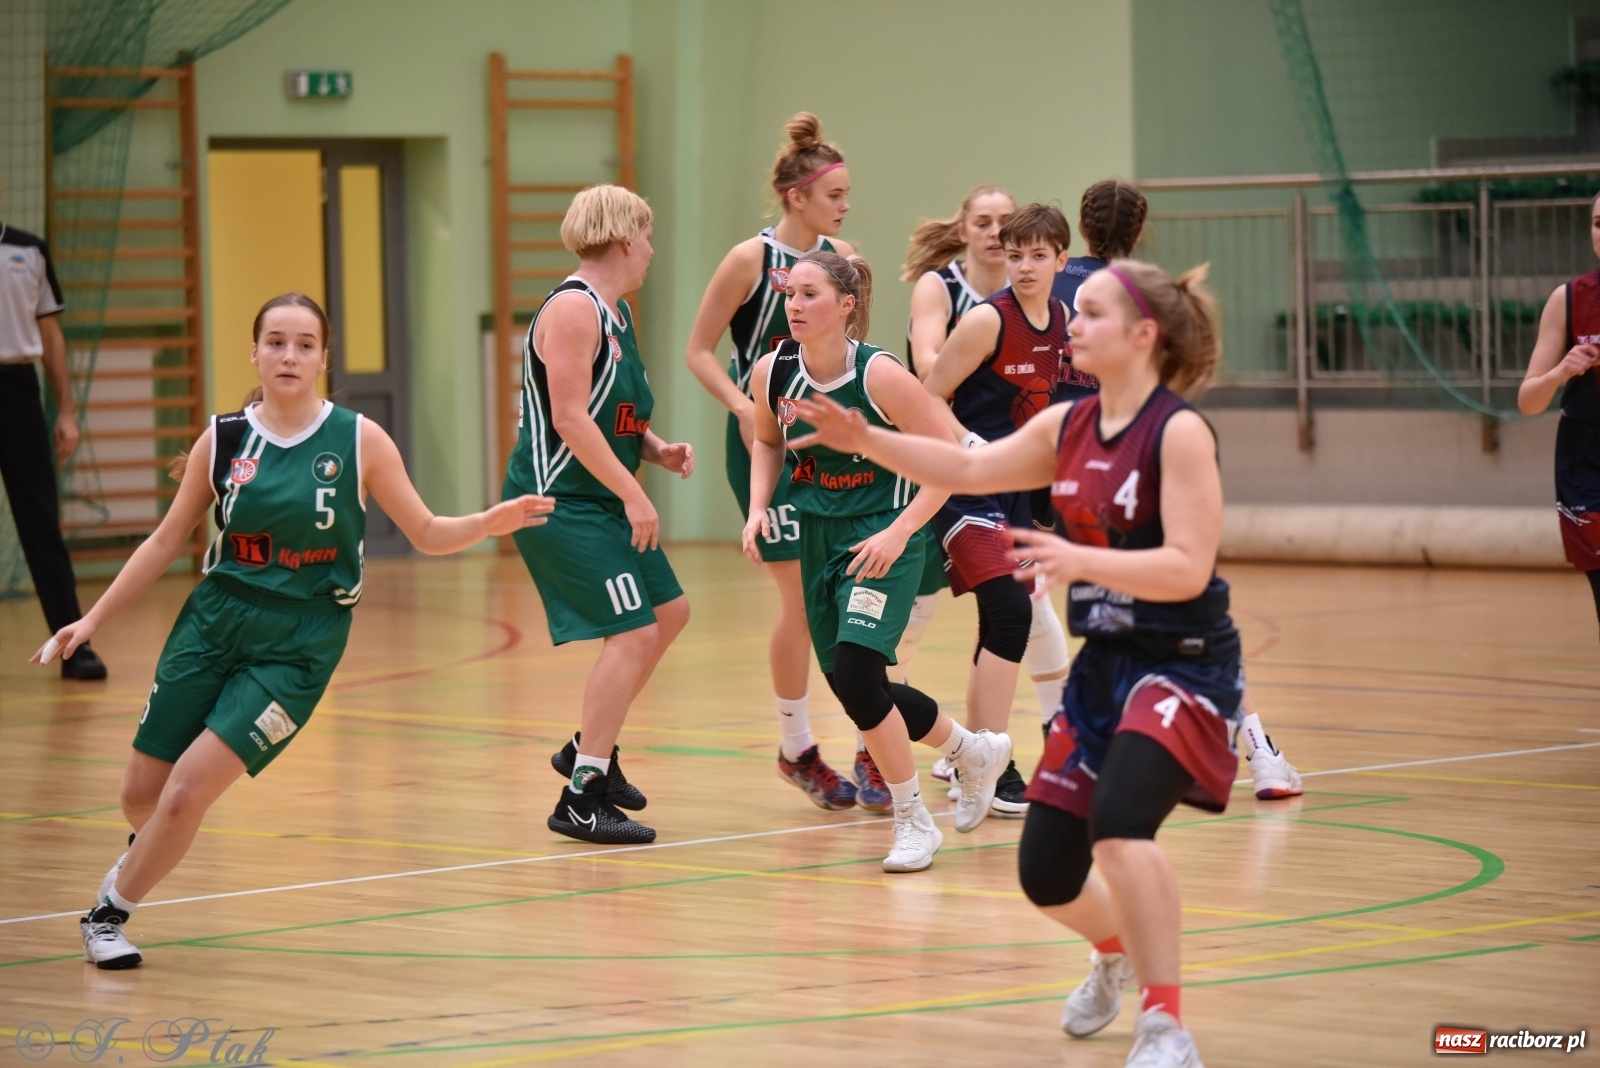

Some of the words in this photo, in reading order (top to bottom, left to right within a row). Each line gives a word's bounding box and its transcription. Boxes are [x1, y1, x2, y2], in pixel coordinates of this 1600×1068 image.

[1057, 361, 1099, 389] OLSKA
[820, 469, 874, 490] KAMAN
[1112, 469, 1140, 521] 4
[315, 487, 336, 530] 5
[605, 572, 642, 615] 10
[847, 617, 877, 629] COLO
[1153, 694, 1181, 729] 4
